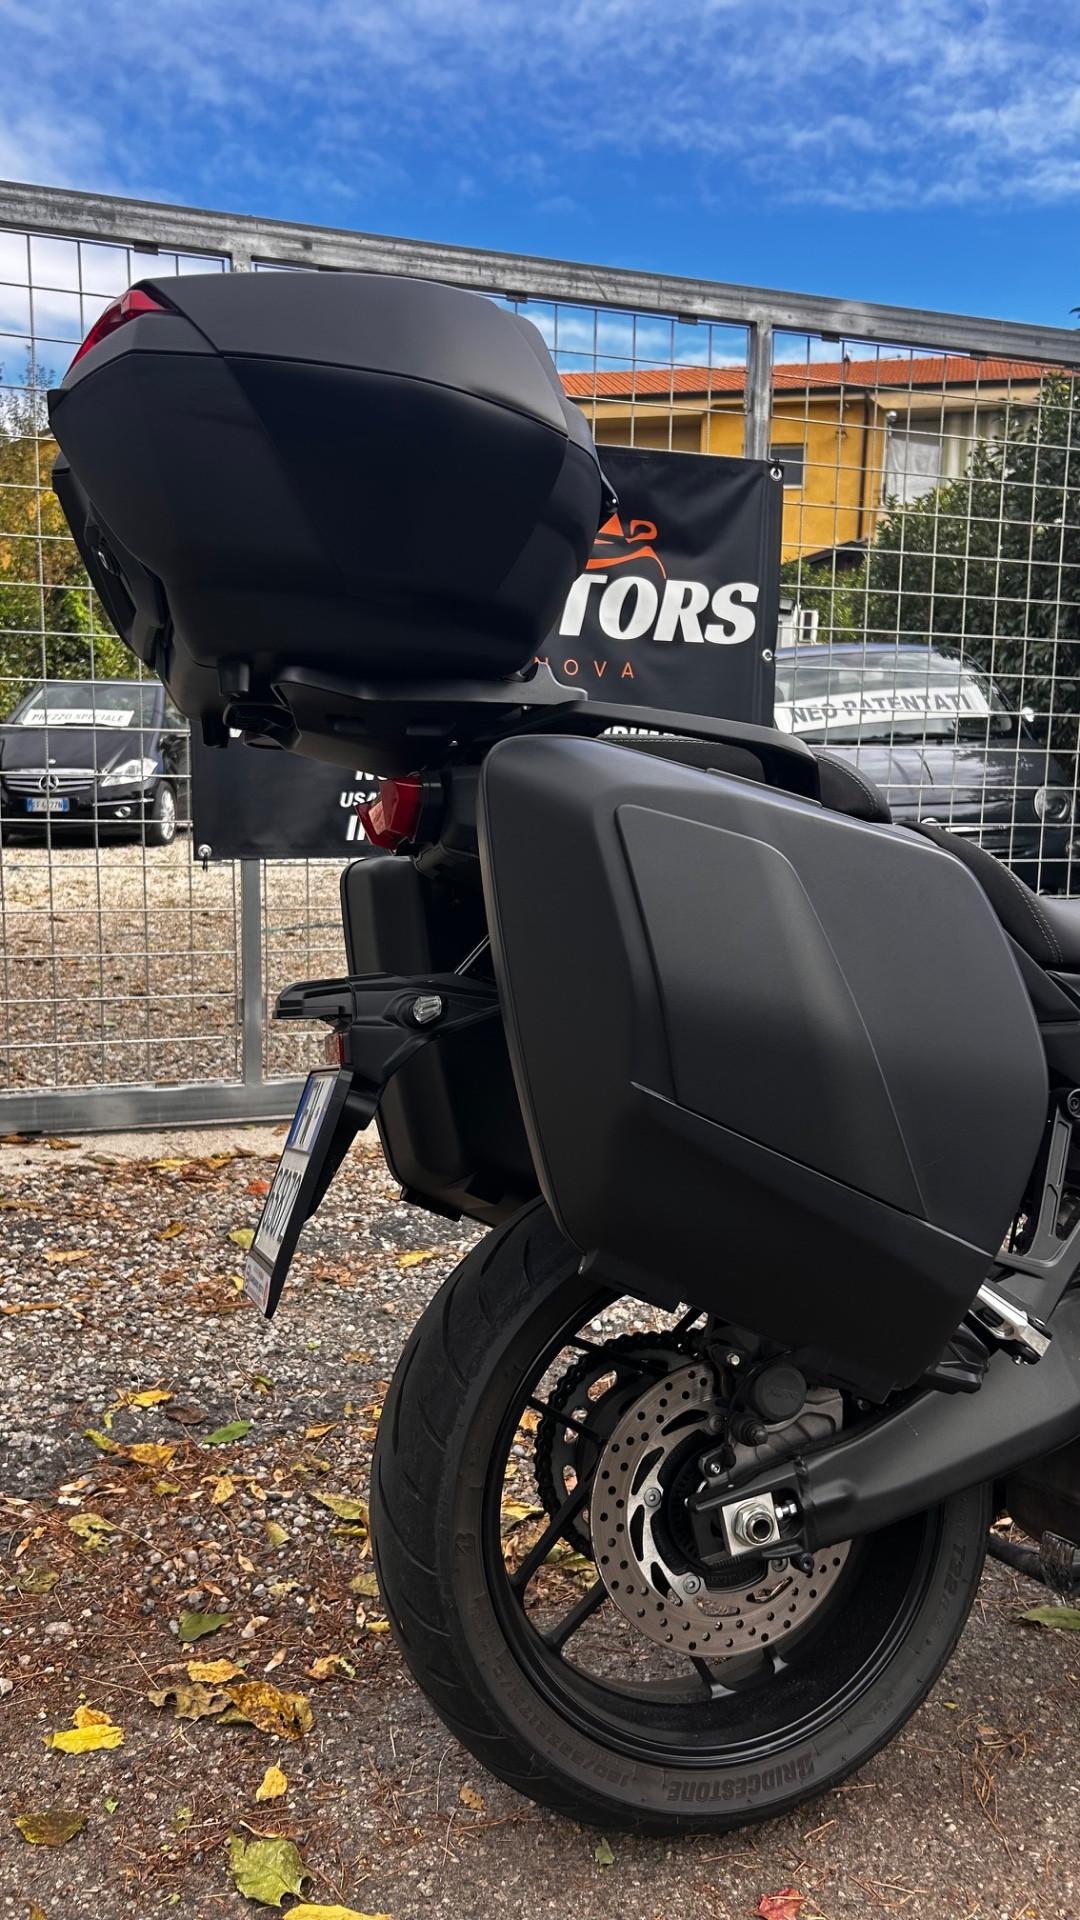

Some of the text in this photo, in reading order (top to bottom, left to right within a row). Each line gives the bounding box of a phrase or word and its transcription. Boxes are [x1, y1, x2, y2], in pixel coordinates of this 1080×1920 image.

[791, 693, 973, 724] NEO PATENTATI
[667, 1752, 816, 1803] BRIDGESTONE
